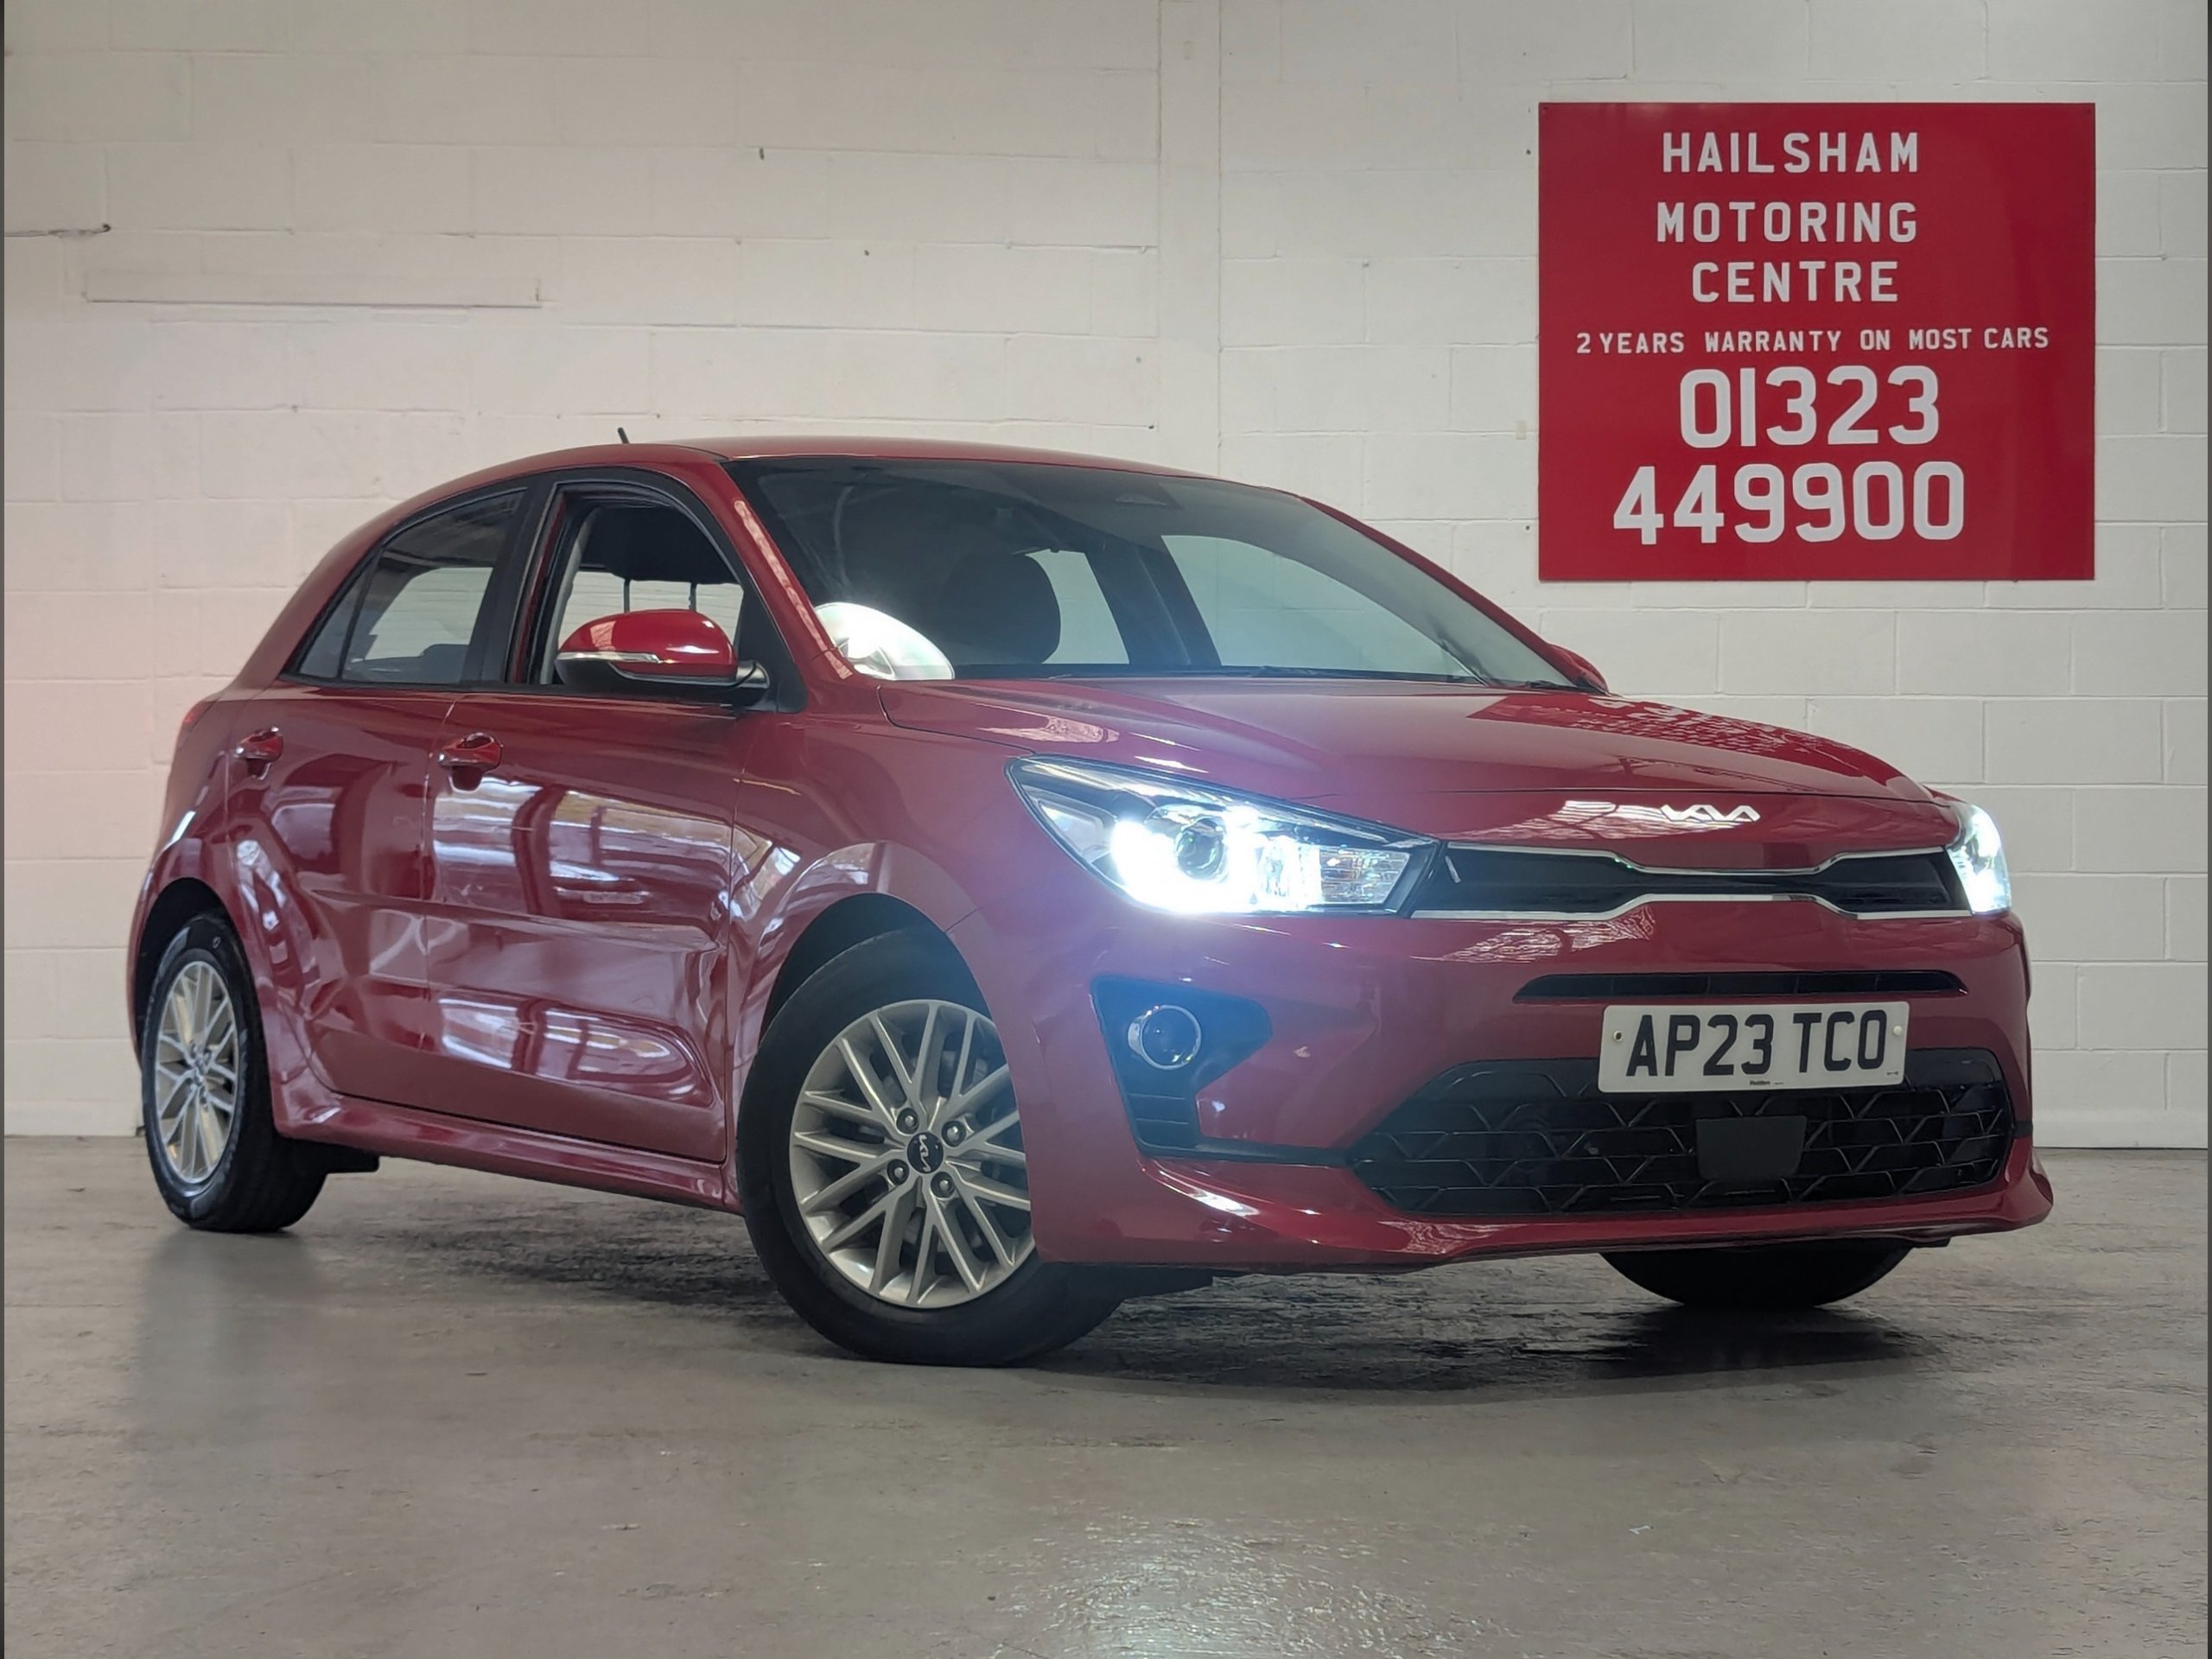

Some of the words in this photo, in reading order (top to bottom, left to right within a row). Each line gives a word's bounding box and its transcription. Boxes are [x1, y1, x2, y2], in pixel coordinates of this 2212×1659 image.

[1662, 131, 1919, 174] HAILSHAM
[1656, 201, 1917, 243] MOTORING
[1692, 260, 1899, 303] CENTRE
[1576, 332, 1592, 354] 2
[1599, 332, 1685, 354] YEARS
[1704, 330, 1842, 353] WARRANTY
[1859, 329, 1891, 351] ON
[1909, 327, 1973, 350] MOST
[1984, 327, 2050, 349] CARS
[1679, 365, 1940, 449] 01323
[1612, 461, 1965, 545] 449900
[1625, 1014, 1775, 1077] AP23
[1792, 1009, 1888, 1074] TCO
